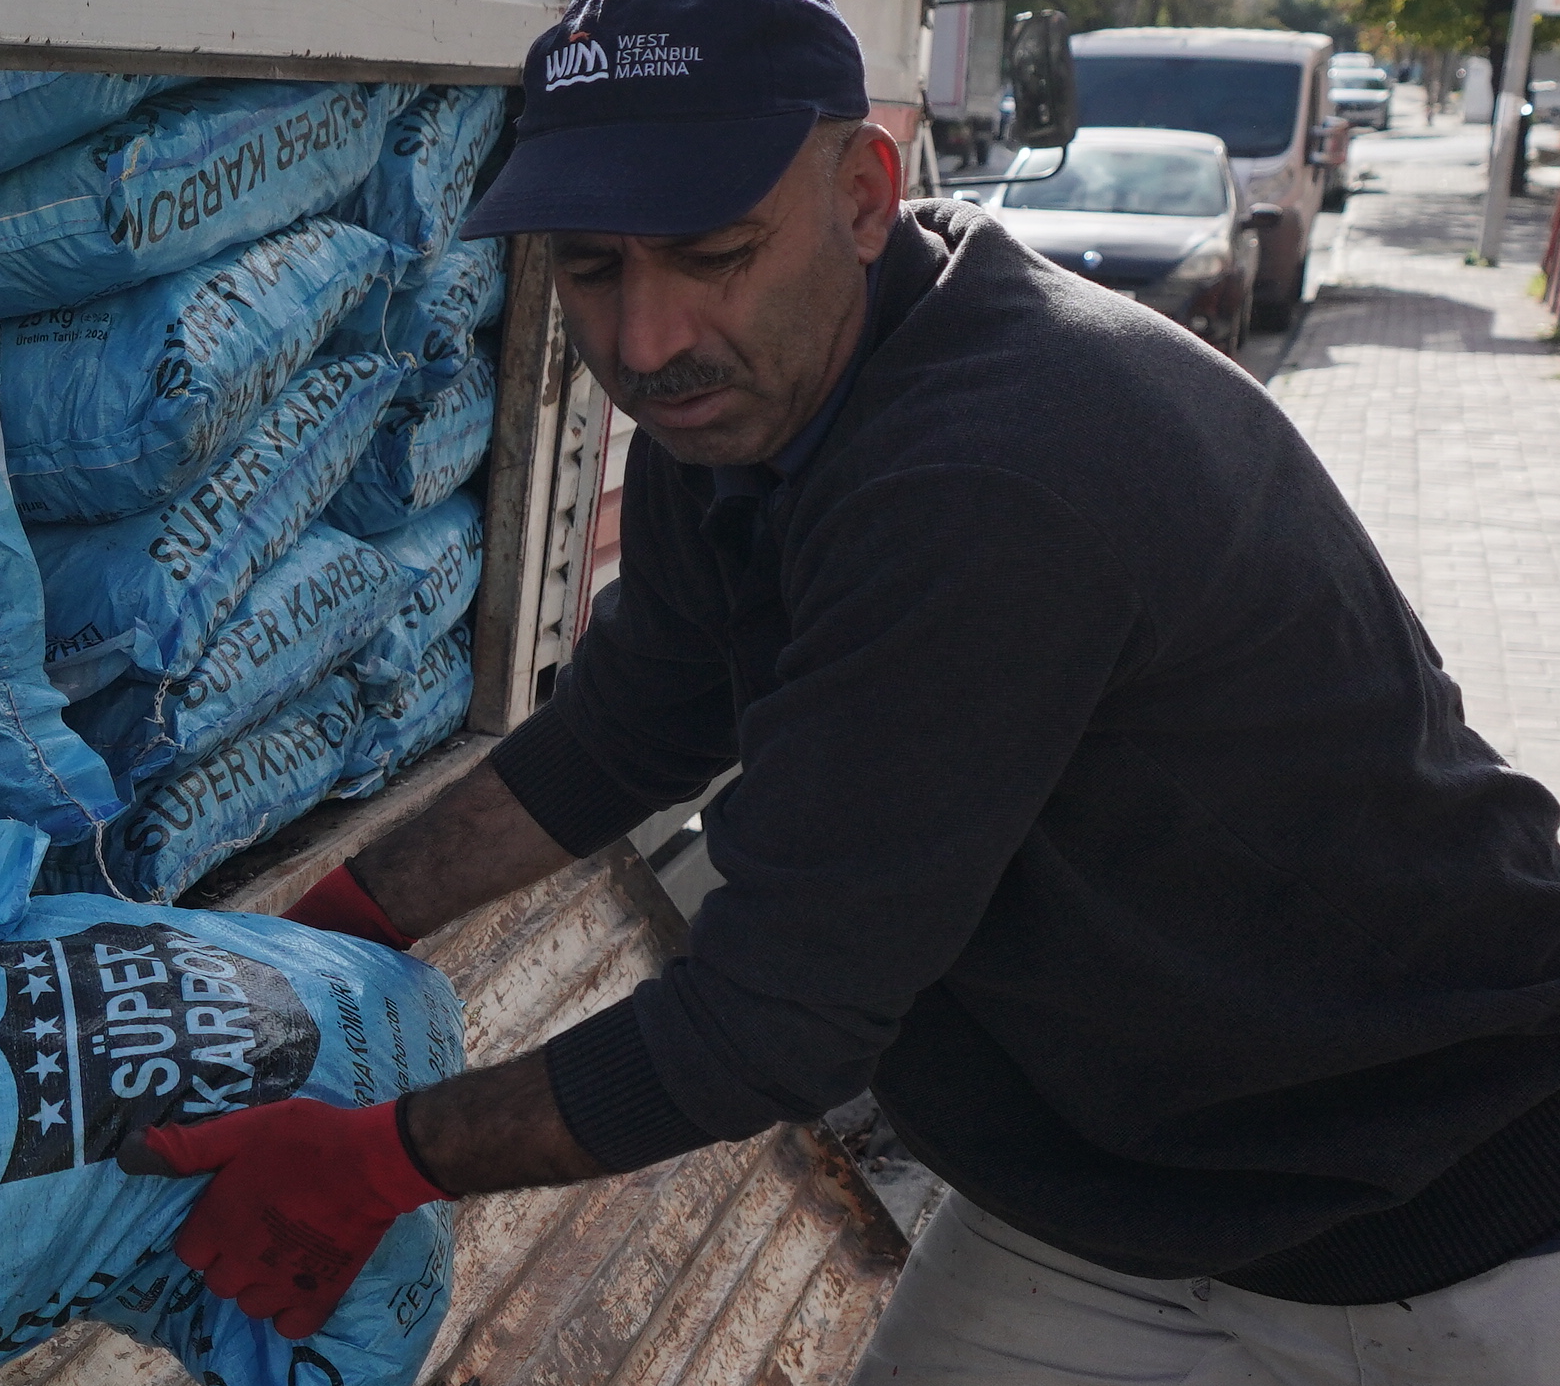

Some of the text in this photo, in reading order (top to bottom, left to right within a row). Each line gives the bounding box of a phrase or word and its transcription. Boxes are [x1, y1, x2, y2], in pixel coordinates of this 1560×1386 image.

[546, 40, 608, 82] WIM
[615, 62, 689, 79] MARINA
[617, 47, 703, 63] ISTANBUL
[618, 34, 669, 49] WEST
[277, 88, 369, 170] SÜPER
[106, 134, 266, 250] KARBON
[16, 333, 48, 345] Üretim
[149, 444, 272, 581] SÜPER
[259, 350, 380, 460] KARBO
[180, 609, 290, 711] SÜPER
[123, 747, 258, 858] SÜPER
[92, 943, 180, 1098] SÜPER
